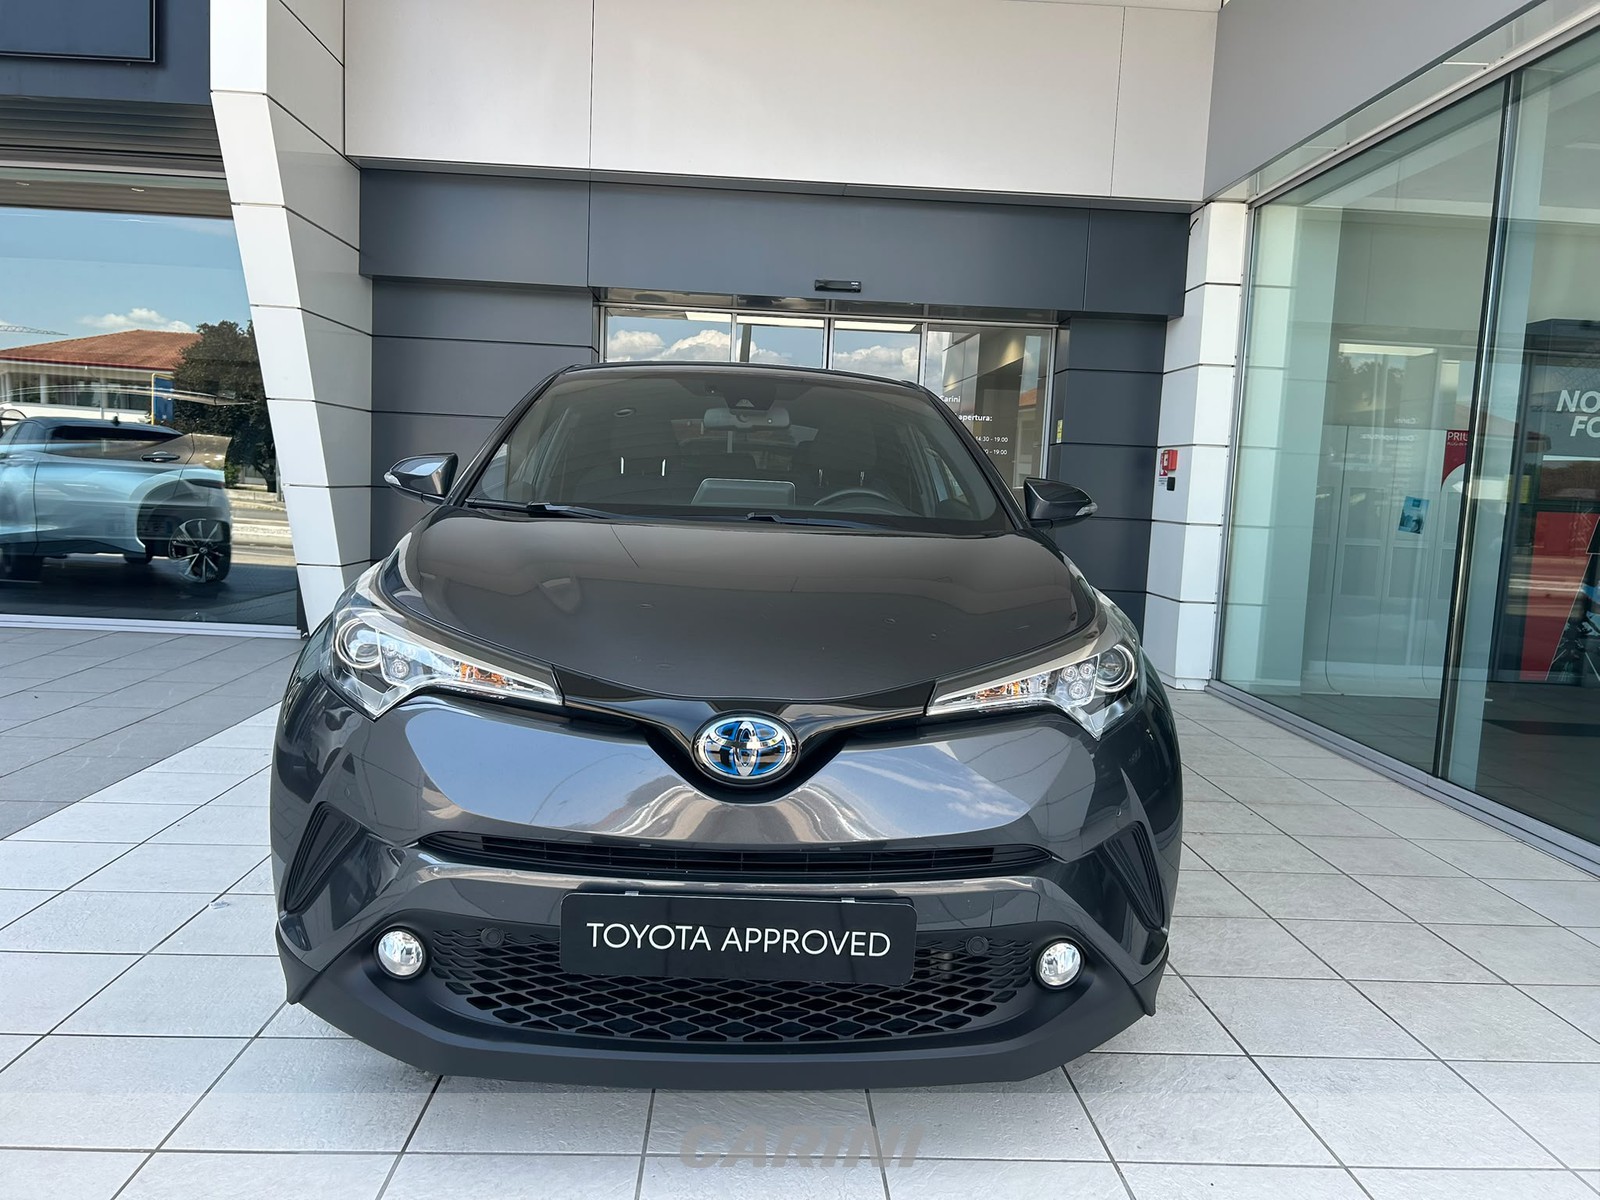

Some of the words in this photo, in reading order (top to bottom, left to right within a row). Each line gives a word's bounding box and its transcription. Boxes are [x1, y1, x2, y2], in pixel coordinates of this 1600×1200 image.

[1556, 389, 1600, 413] NO
[586, 922, 712, 952] TOYOTA
[721, 928, 891, 957] APPROVED
